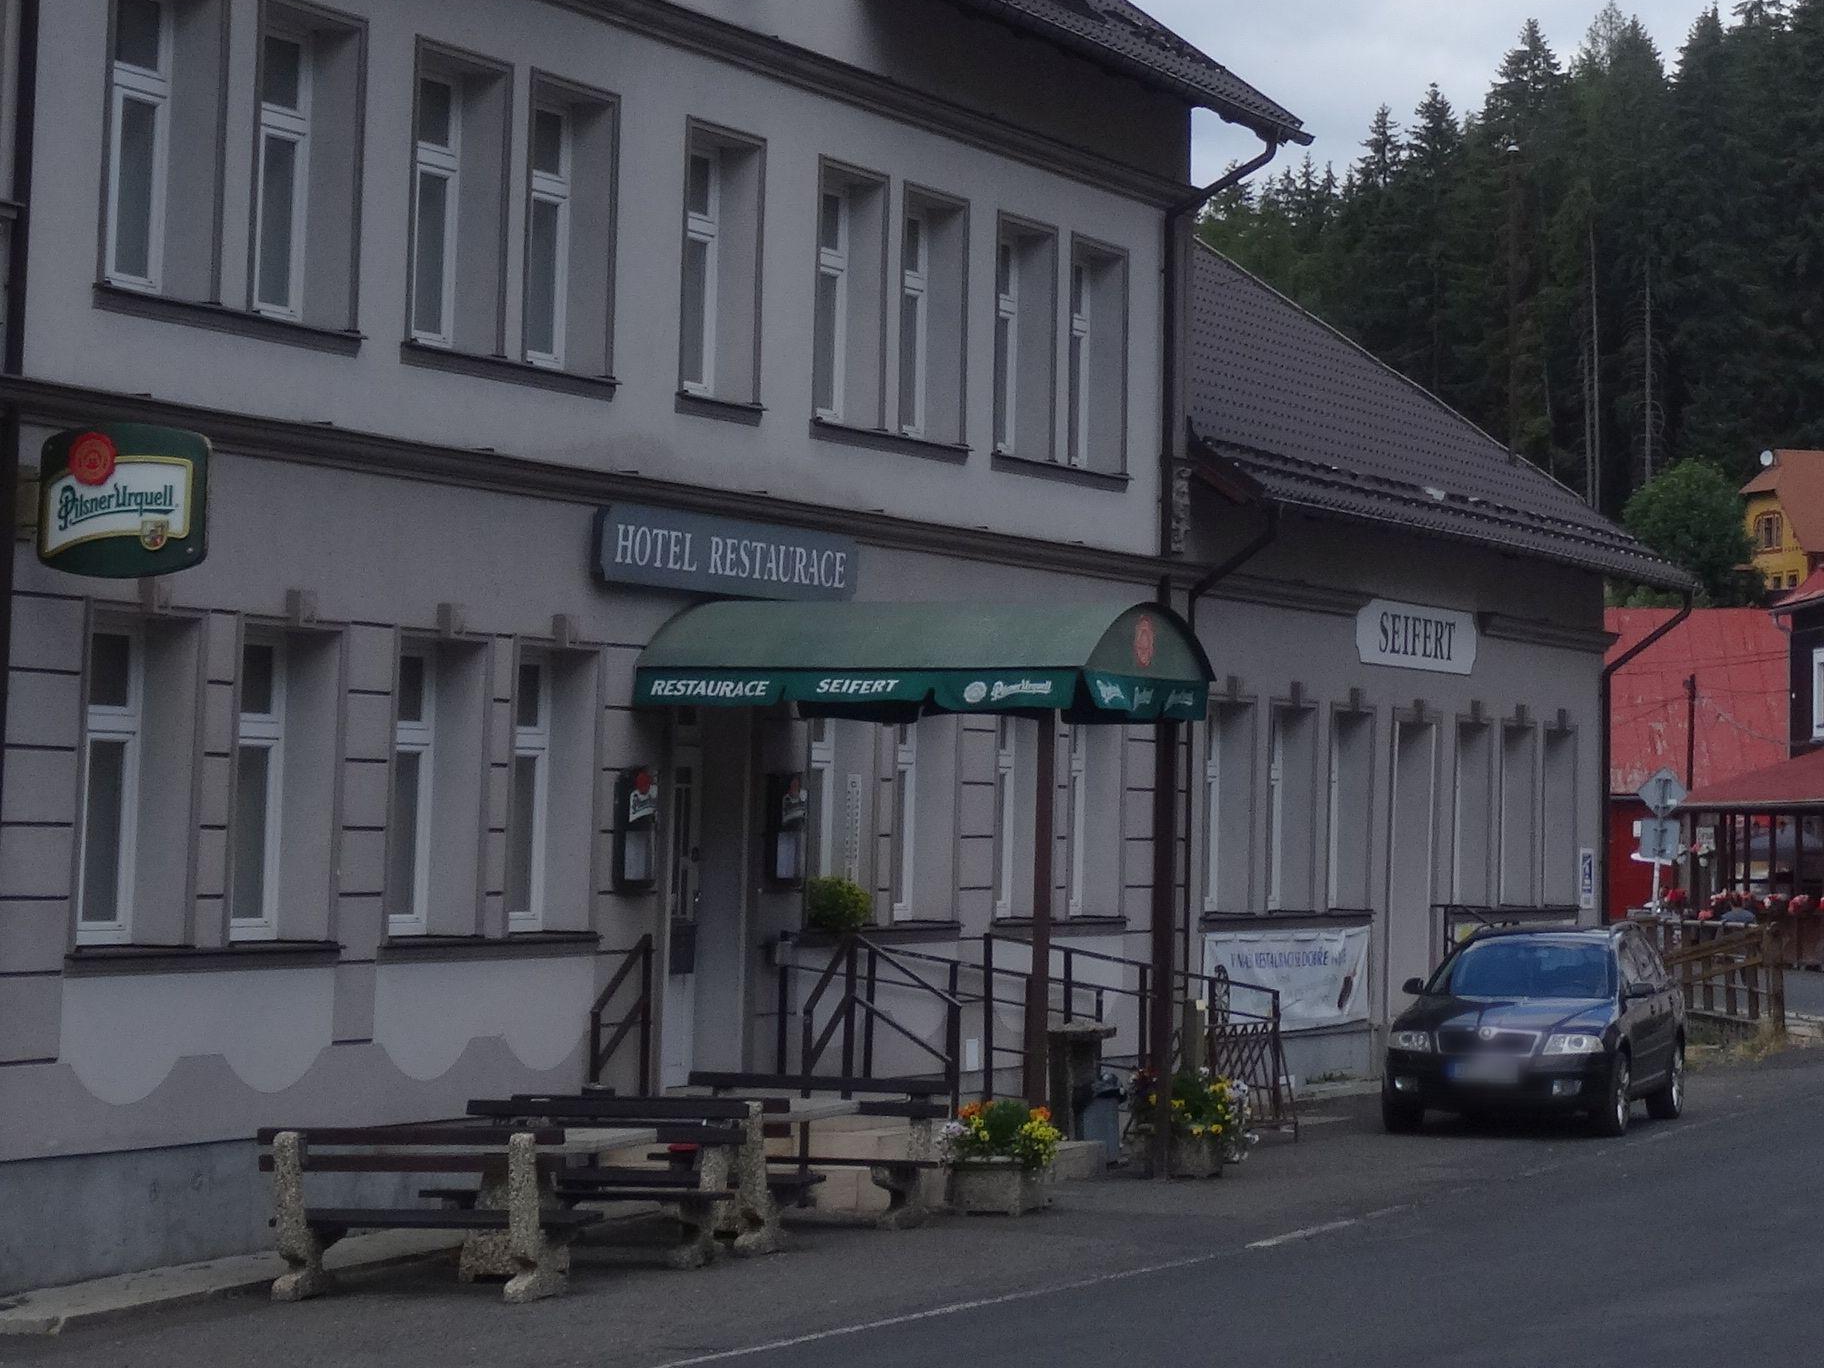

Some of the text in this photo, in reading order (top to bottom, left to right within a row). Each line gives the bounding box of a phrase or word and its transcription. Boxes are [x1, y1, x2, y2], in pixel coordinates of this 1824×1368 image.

[58, 483, 173, 530] Pilsner Urquell
[615, 524, 846, 588] HOTEL RESTAURACE
[1379, 612, 1456, 661] SEIFERT
[651, 680, 769, 697] RESTAURACE
[816, 679, 898, 693] SEIFERT
